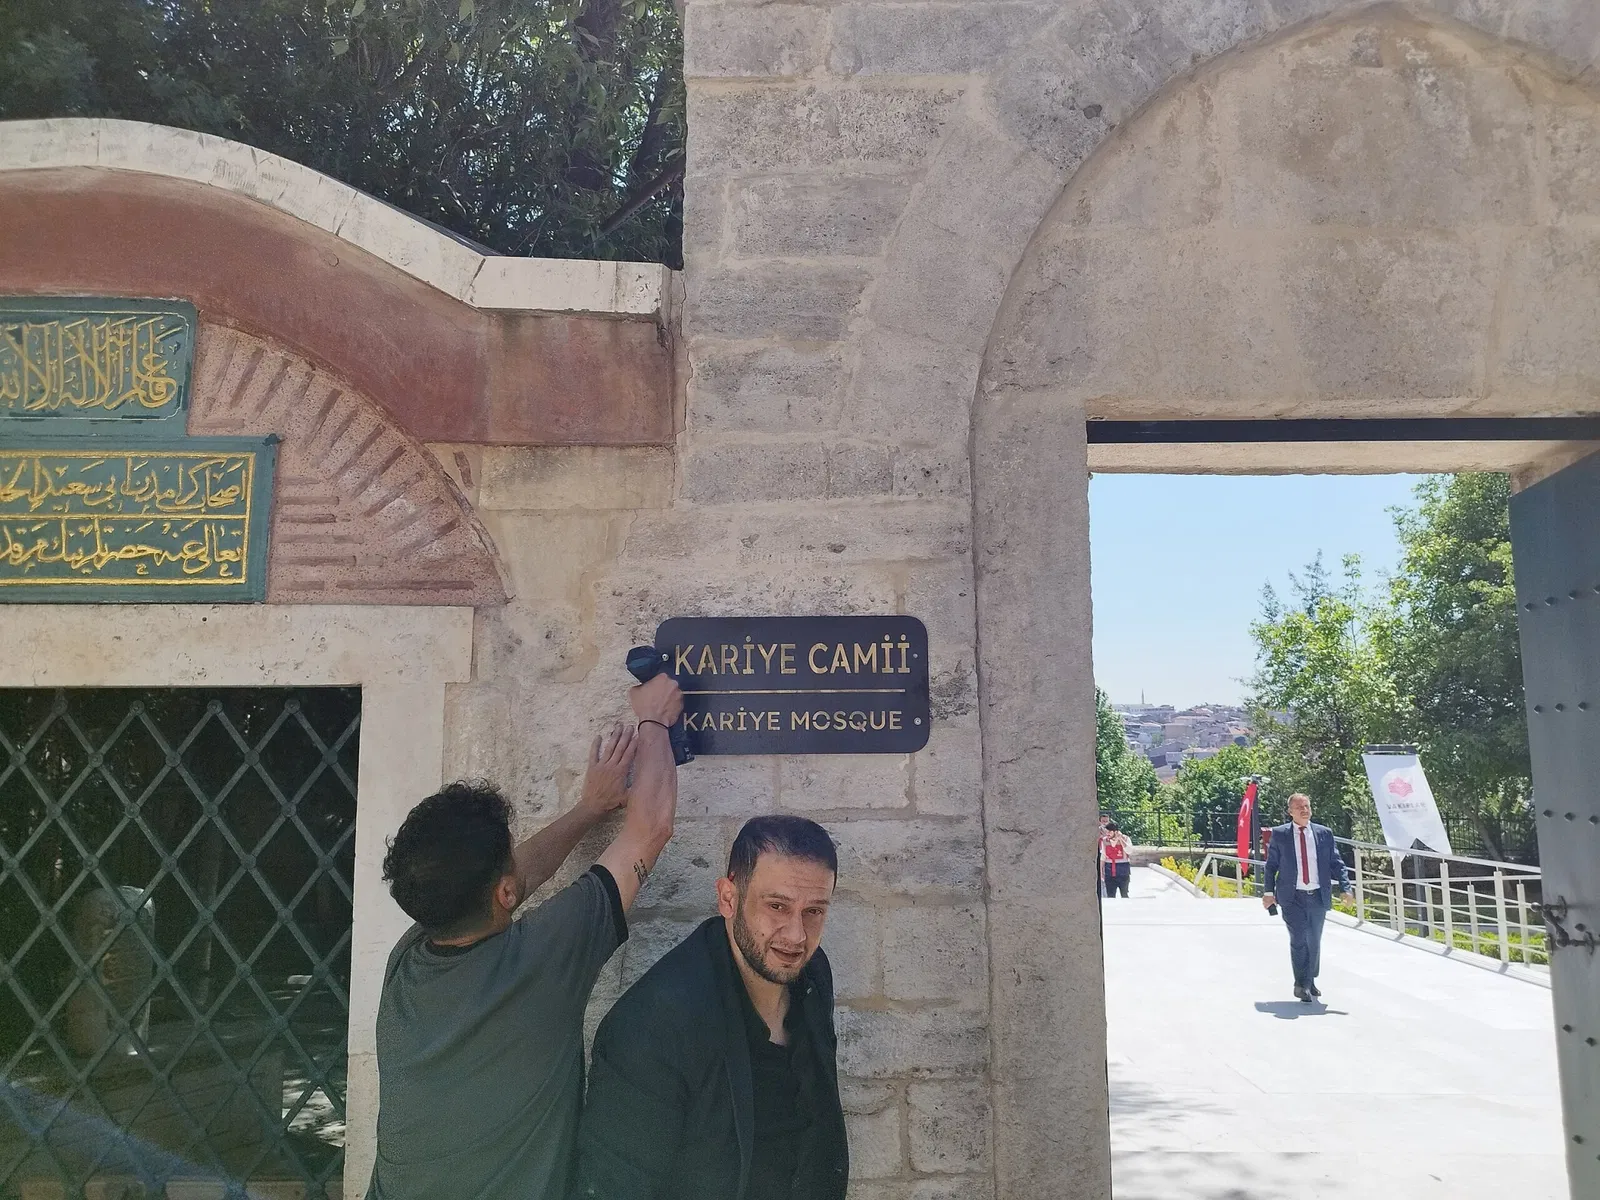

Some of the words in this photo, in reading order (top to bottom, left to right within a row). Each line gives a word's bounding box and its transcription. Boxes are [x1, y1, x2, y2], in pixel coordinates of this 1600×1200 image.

[674, 635, 797, 676] KARİYE
[808, 633, 911, 675] CAMİİ
[683, 706, 781, 732] KARİYE
[791, 710, 903, 733] MOSQUE
